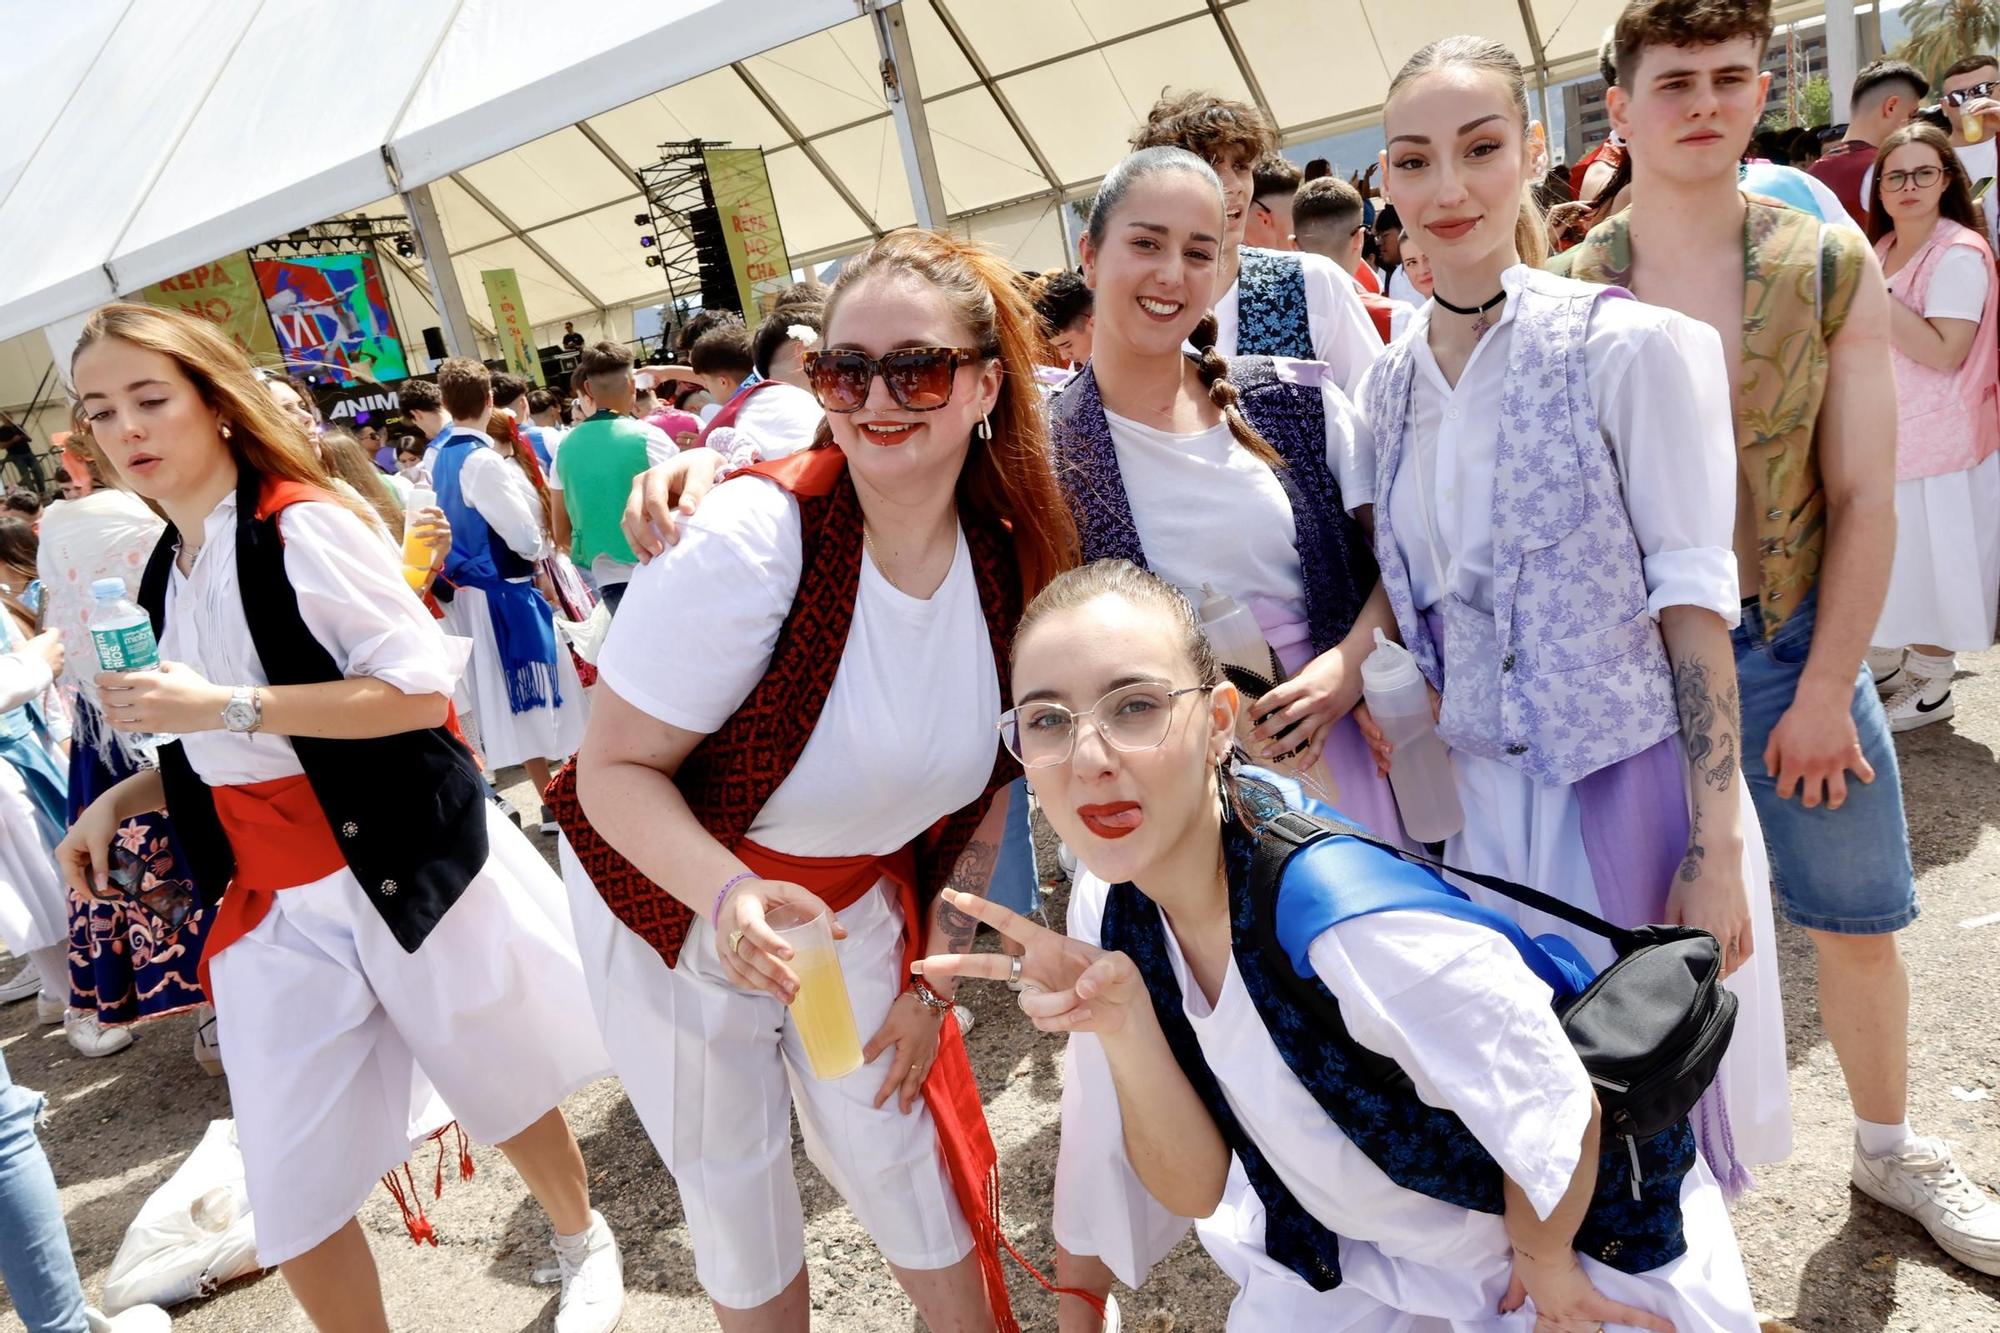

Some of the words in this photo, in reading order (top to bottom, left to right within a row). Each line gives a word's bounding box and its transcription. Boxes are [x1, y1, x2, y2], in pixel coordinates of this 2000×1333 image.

[731, 213, 769, 233] REPA
[744, 239, 769, 256] NO
[746, 262, 778, 281] CHA
[95, 632, 113, 669] HUERTA
[109, 645, 126, 668] RIOS
